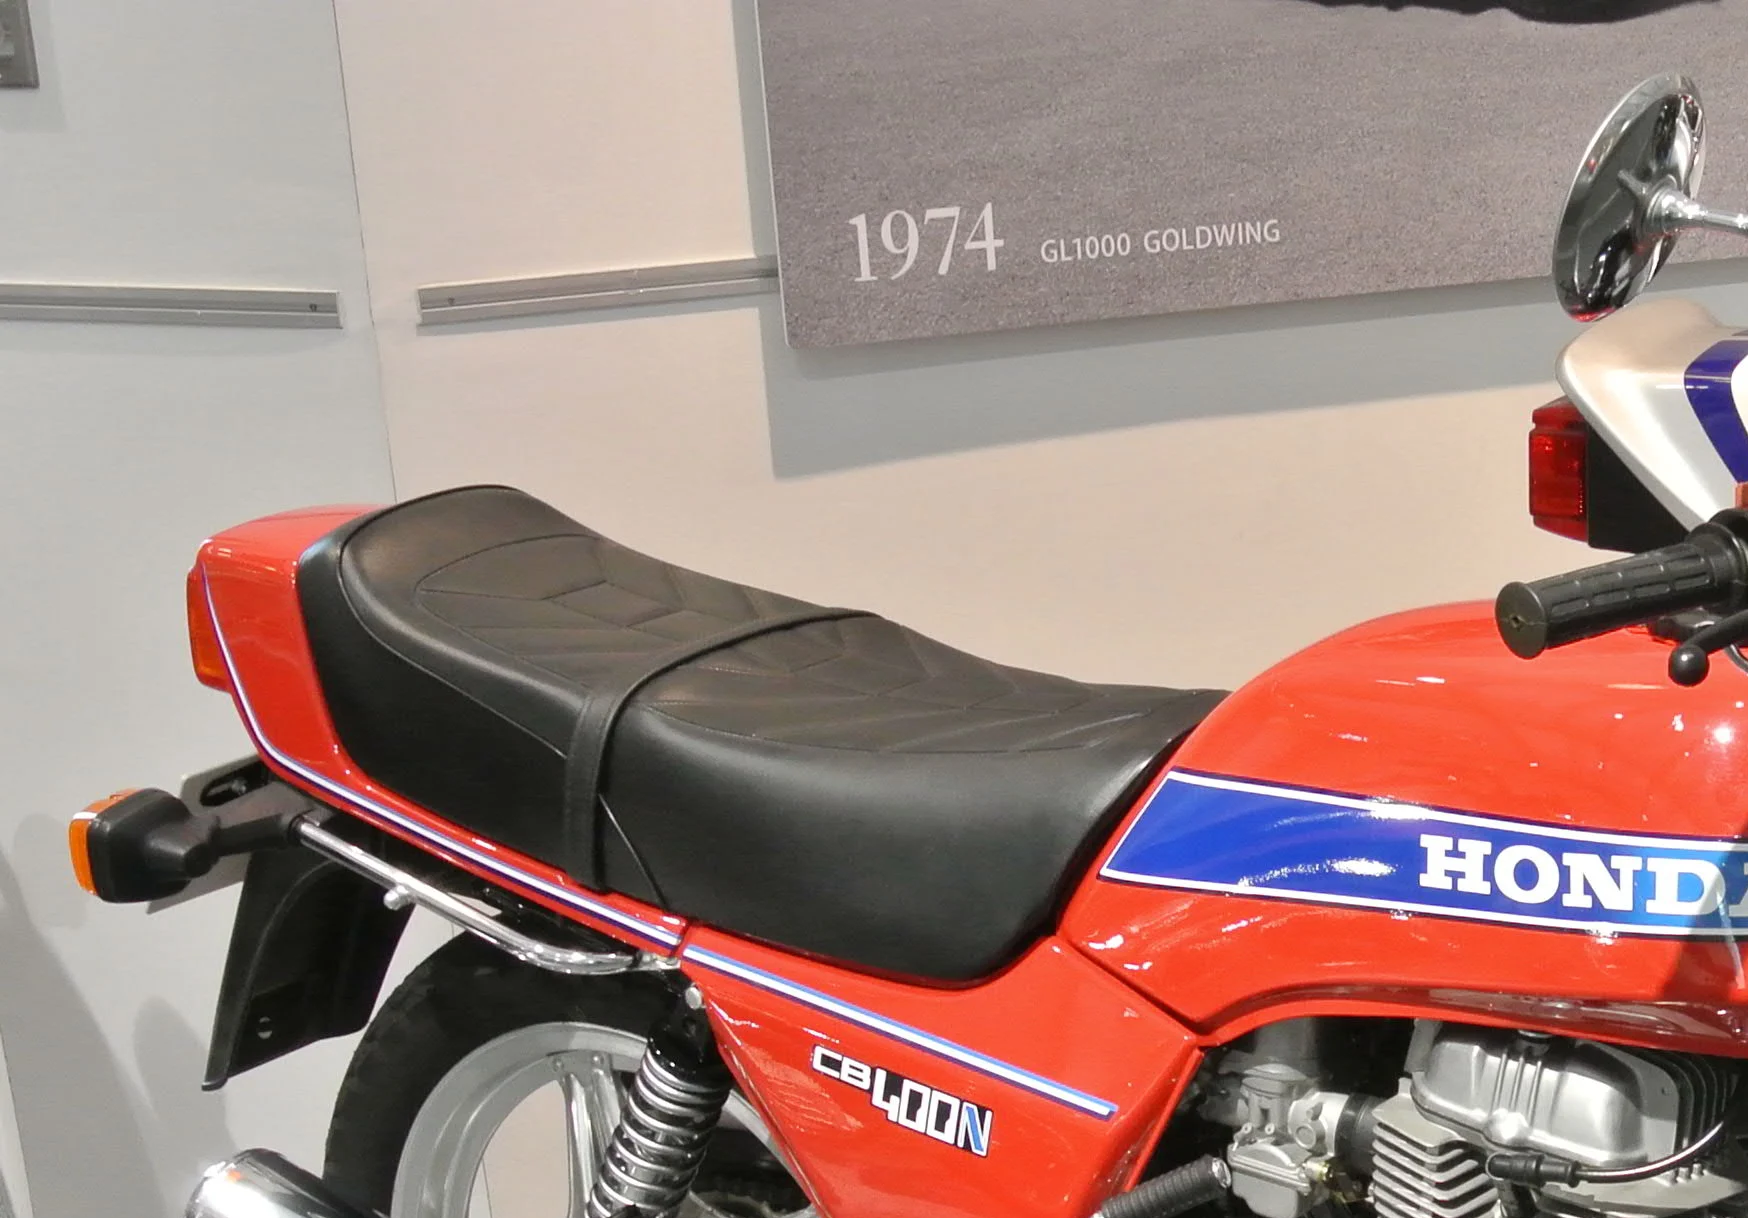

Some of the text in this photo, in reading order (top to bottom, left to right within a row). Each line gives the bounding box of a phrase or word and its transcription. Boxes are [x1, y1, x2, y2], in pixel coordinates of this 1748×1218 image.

[848, 202, 1281, 282] 1974 GL1000 GOLDWING
[811, 1044, 994, 1158] CB400N
